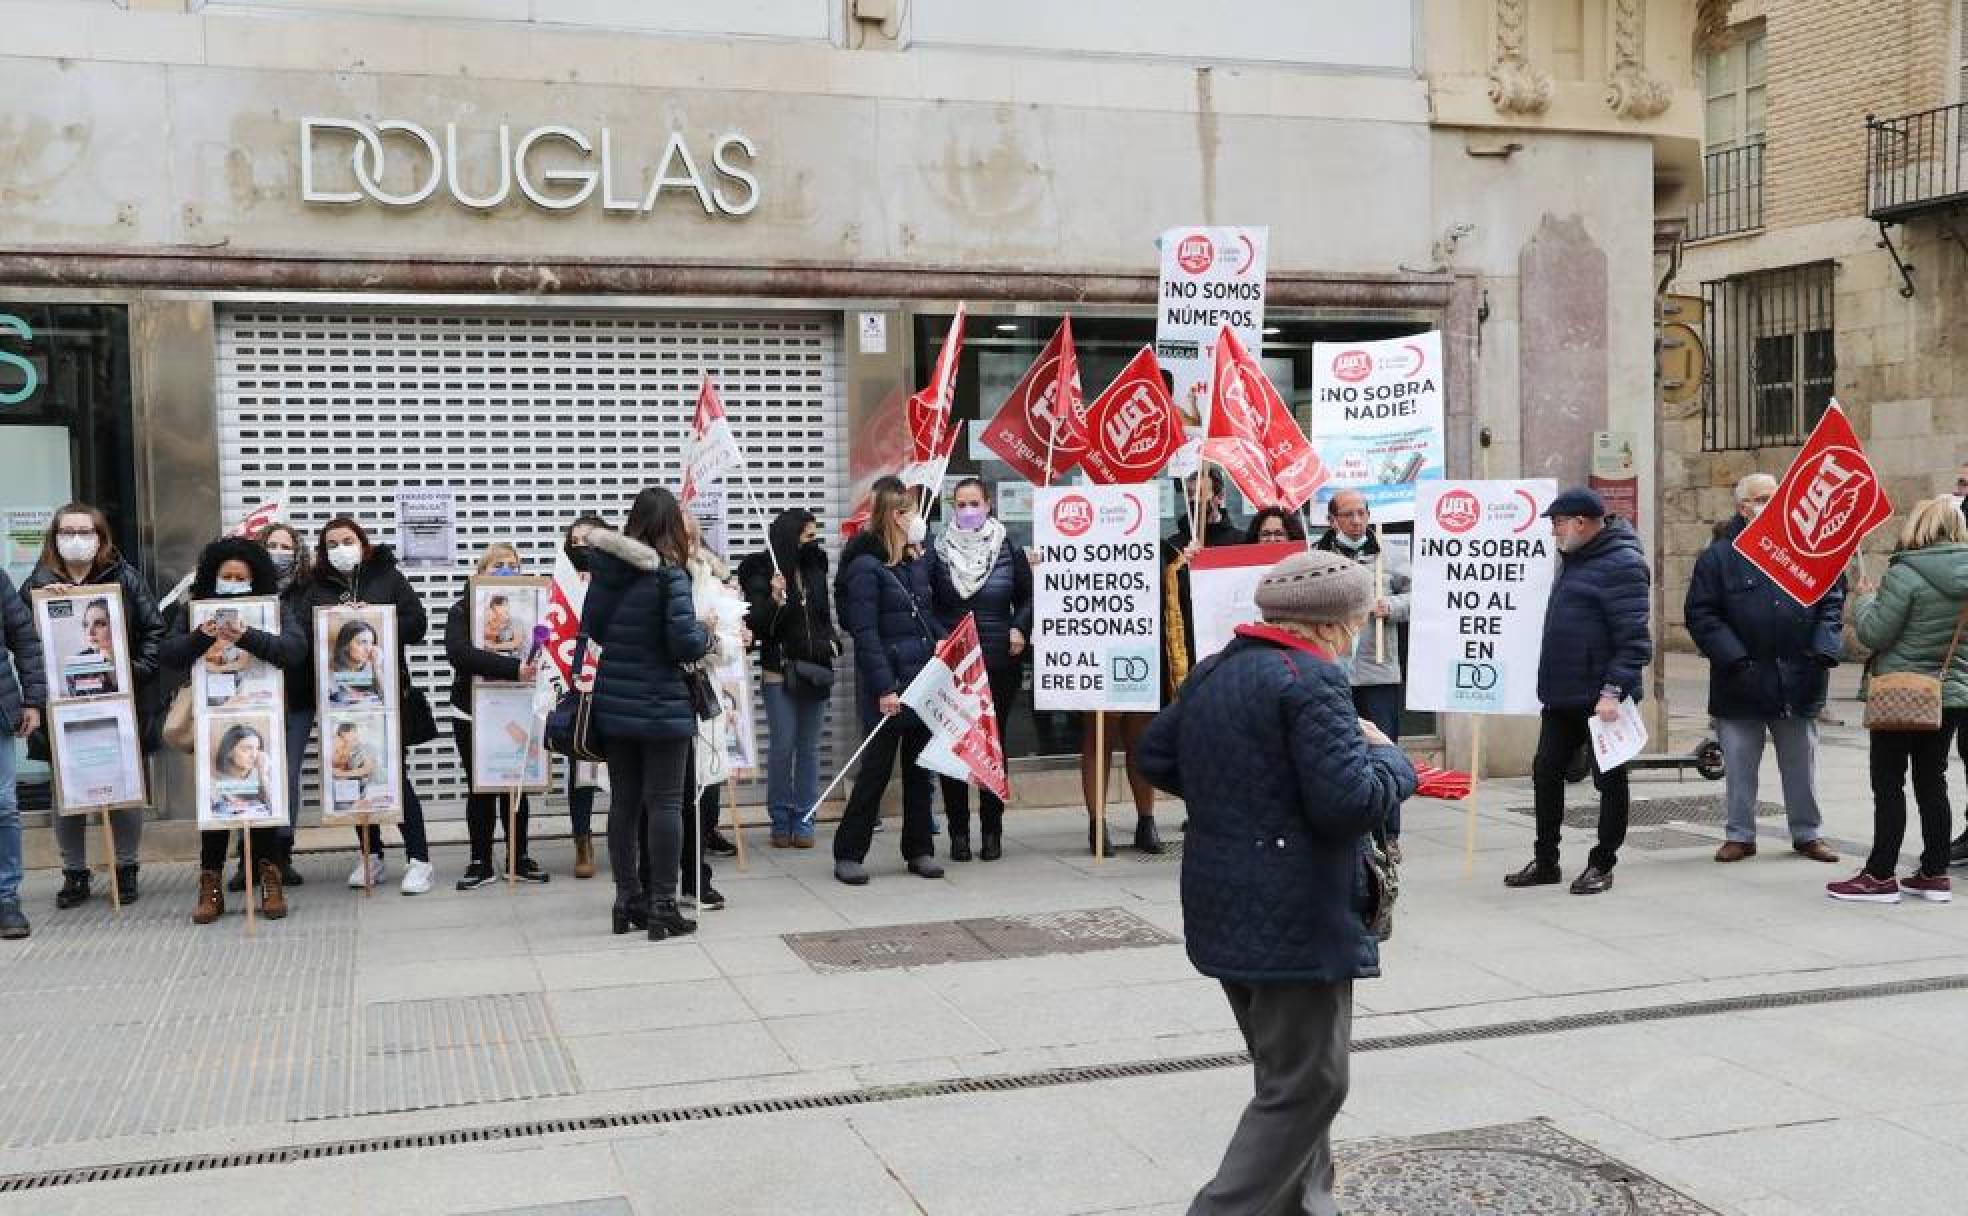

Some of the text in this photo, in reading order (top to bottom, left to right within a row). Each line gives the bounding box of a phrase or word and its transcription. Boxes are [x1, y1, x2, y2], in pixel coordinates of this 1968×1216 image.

[301, 117, 761, 217] DOUGLAS
[1164, 281, 1261, 300] ¡NO SOMOS
[1319, 378, 1436, 403] ¡NO SOBRA
[1106, 385, 1157, 448] UGT
[1344, 400, 1417, 420] NADIE!
[1791, 453, 1855, 537] UGT
[1083, 542, 1155, 563] SOMOS
[1421, 537, 1547, 558] ¡NO SOBRA
[1045, 569, 1150, 592] NÚMEROS,
[1447, 562, 1525, 582] NADIE!
[1062, 594, 1135, 613] SOMOS
[1447, 591, 1517, 610] NO AL
[1042, 617, 1153, 637] PERSONAS!
[1459, 615, 1503, 634] ERE
[1045, 651, 1100, 667] NO AL
[1465, 641, 1494, 659] EN
[1041, 674, 1105, 690] ERE DE
